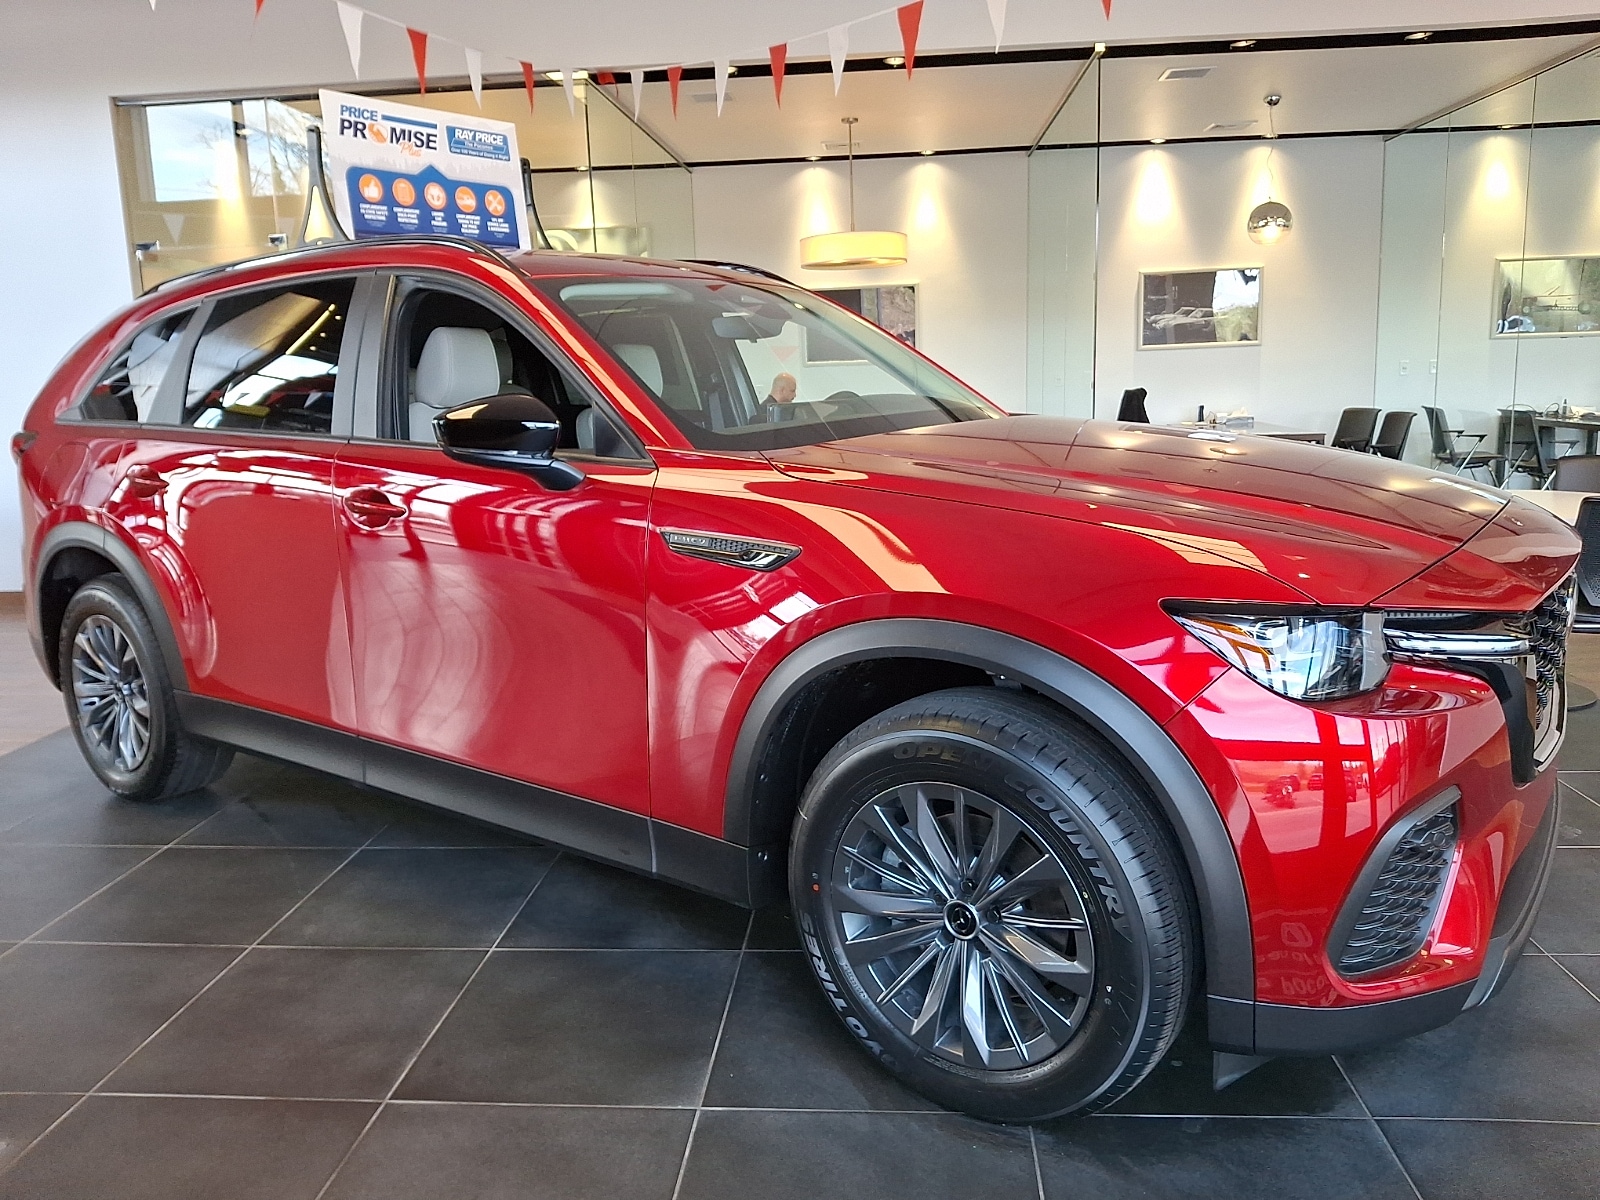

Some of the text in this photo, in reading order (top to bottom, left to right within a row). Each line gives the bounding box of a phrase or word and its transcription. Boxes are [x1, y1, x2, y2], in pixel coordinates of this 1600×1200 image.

[339, 104, 379, 122] PRICE
[454, 128, 504, 146] RAY PRICE
[400, 141, 422, 158] Plus
[801, 911, 849, 1013] TIRES
